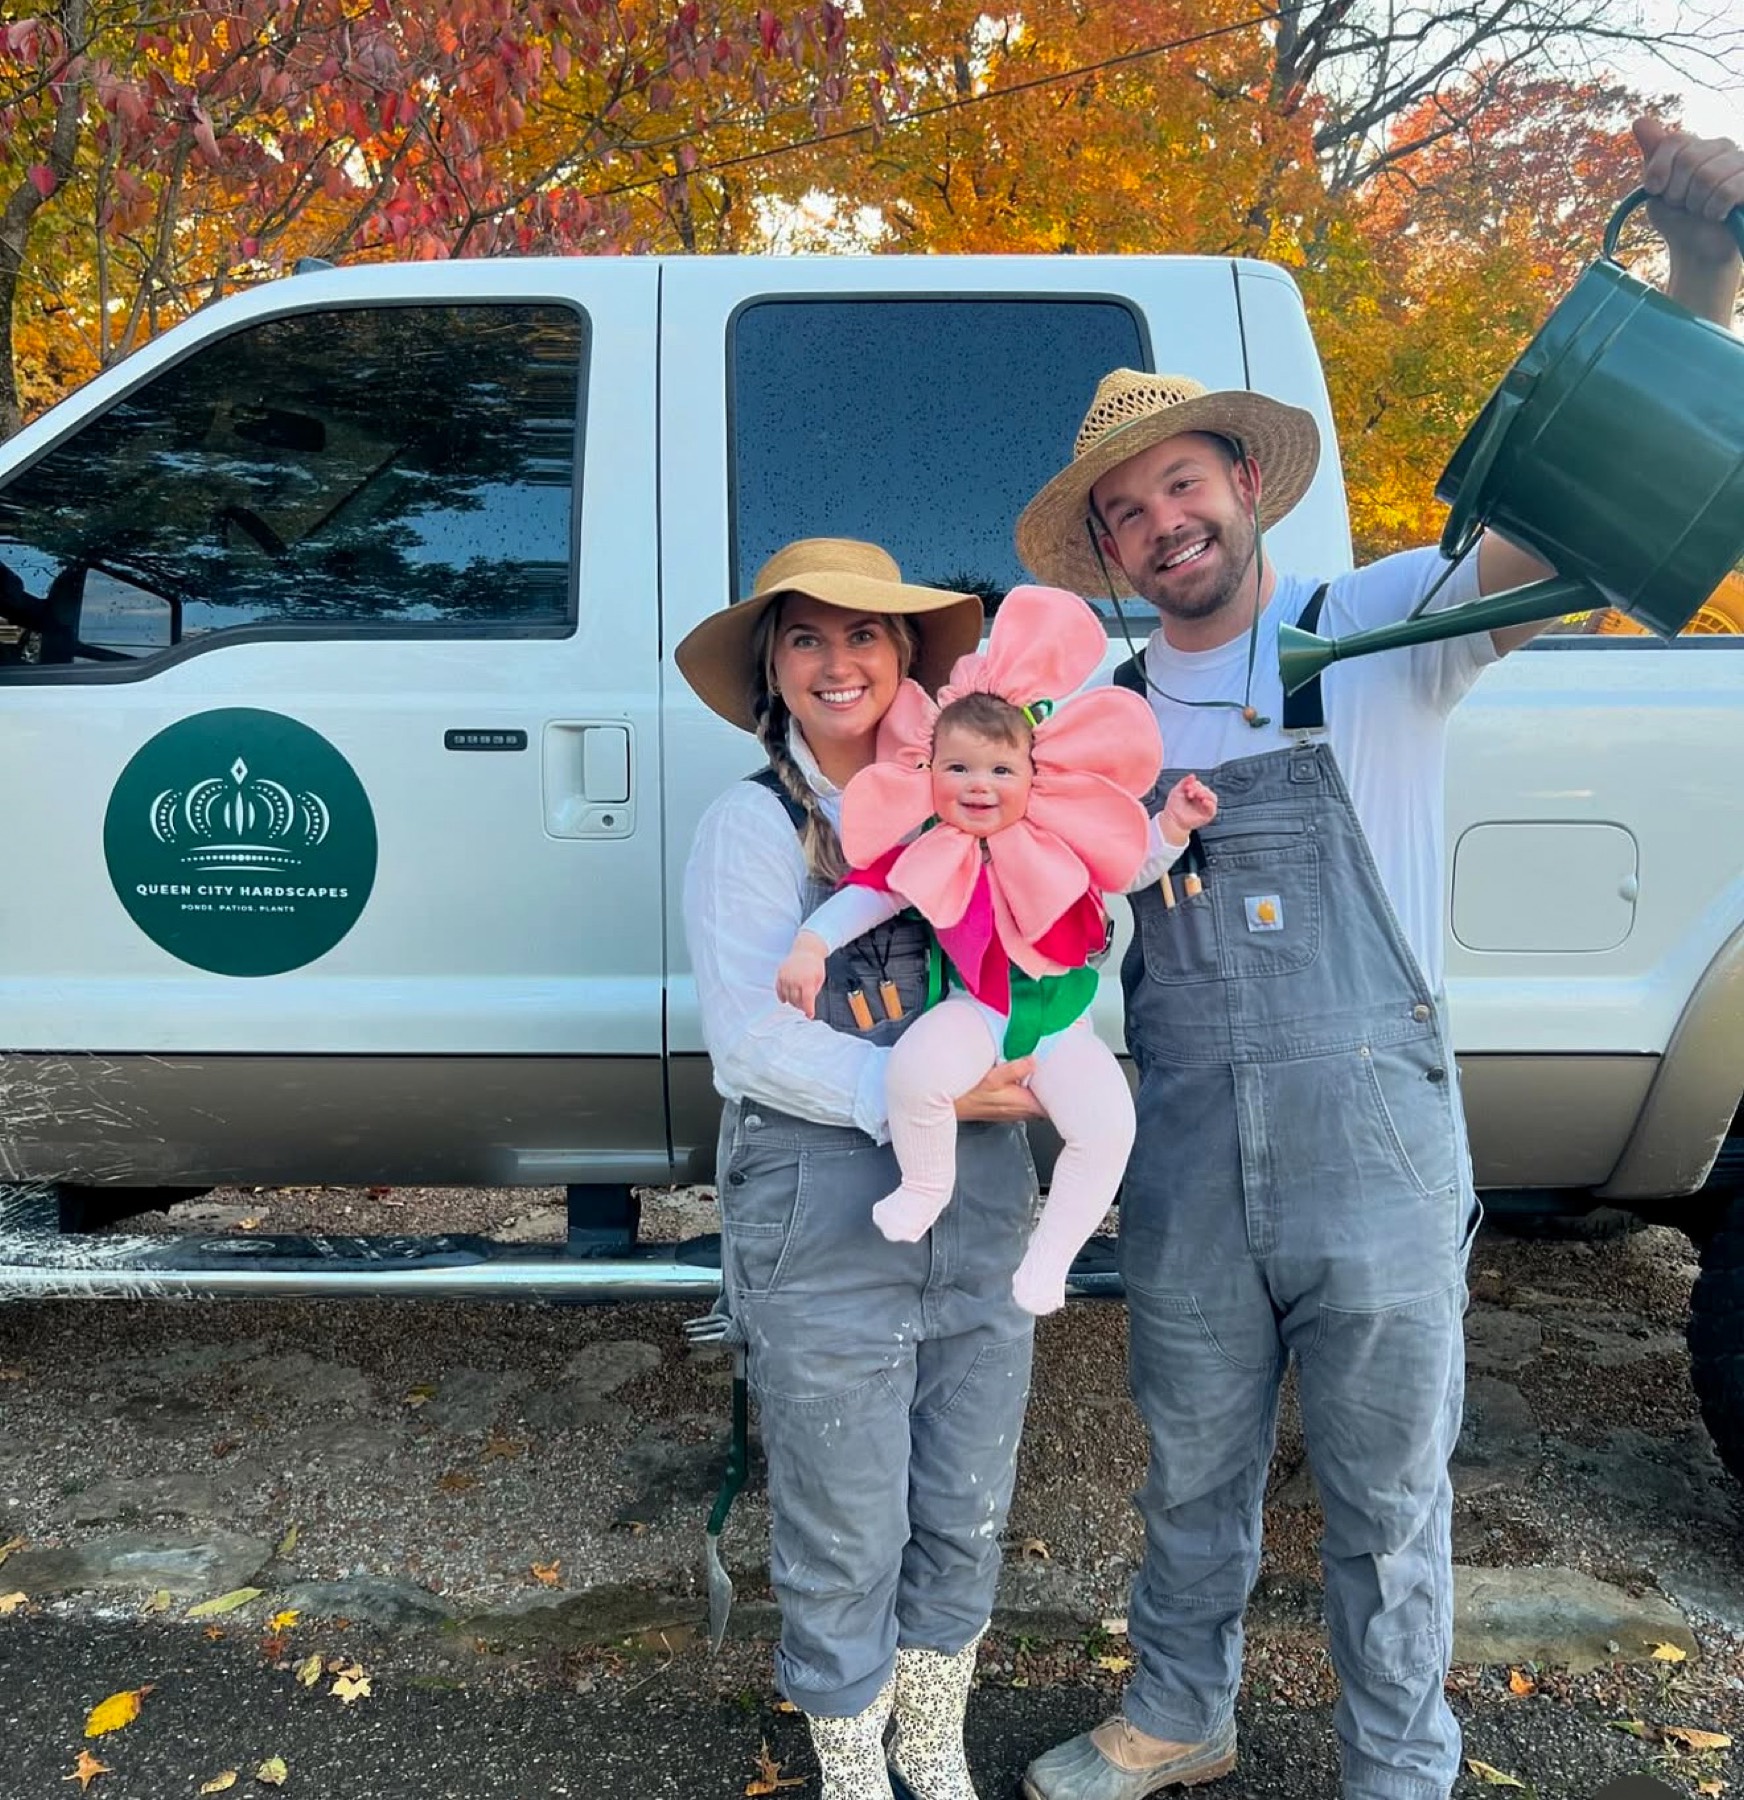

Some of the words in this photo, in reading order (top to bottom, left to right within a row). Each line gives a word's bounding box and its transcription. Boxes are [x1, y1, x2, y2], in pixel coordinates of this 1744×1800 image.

[136, 883, 191, 896] QUEEN
[197, 885, 233, 896] CITY
[240, 886, 348, 898] HARDSCAPES
[260, 905, 295, 913] PLANTS
